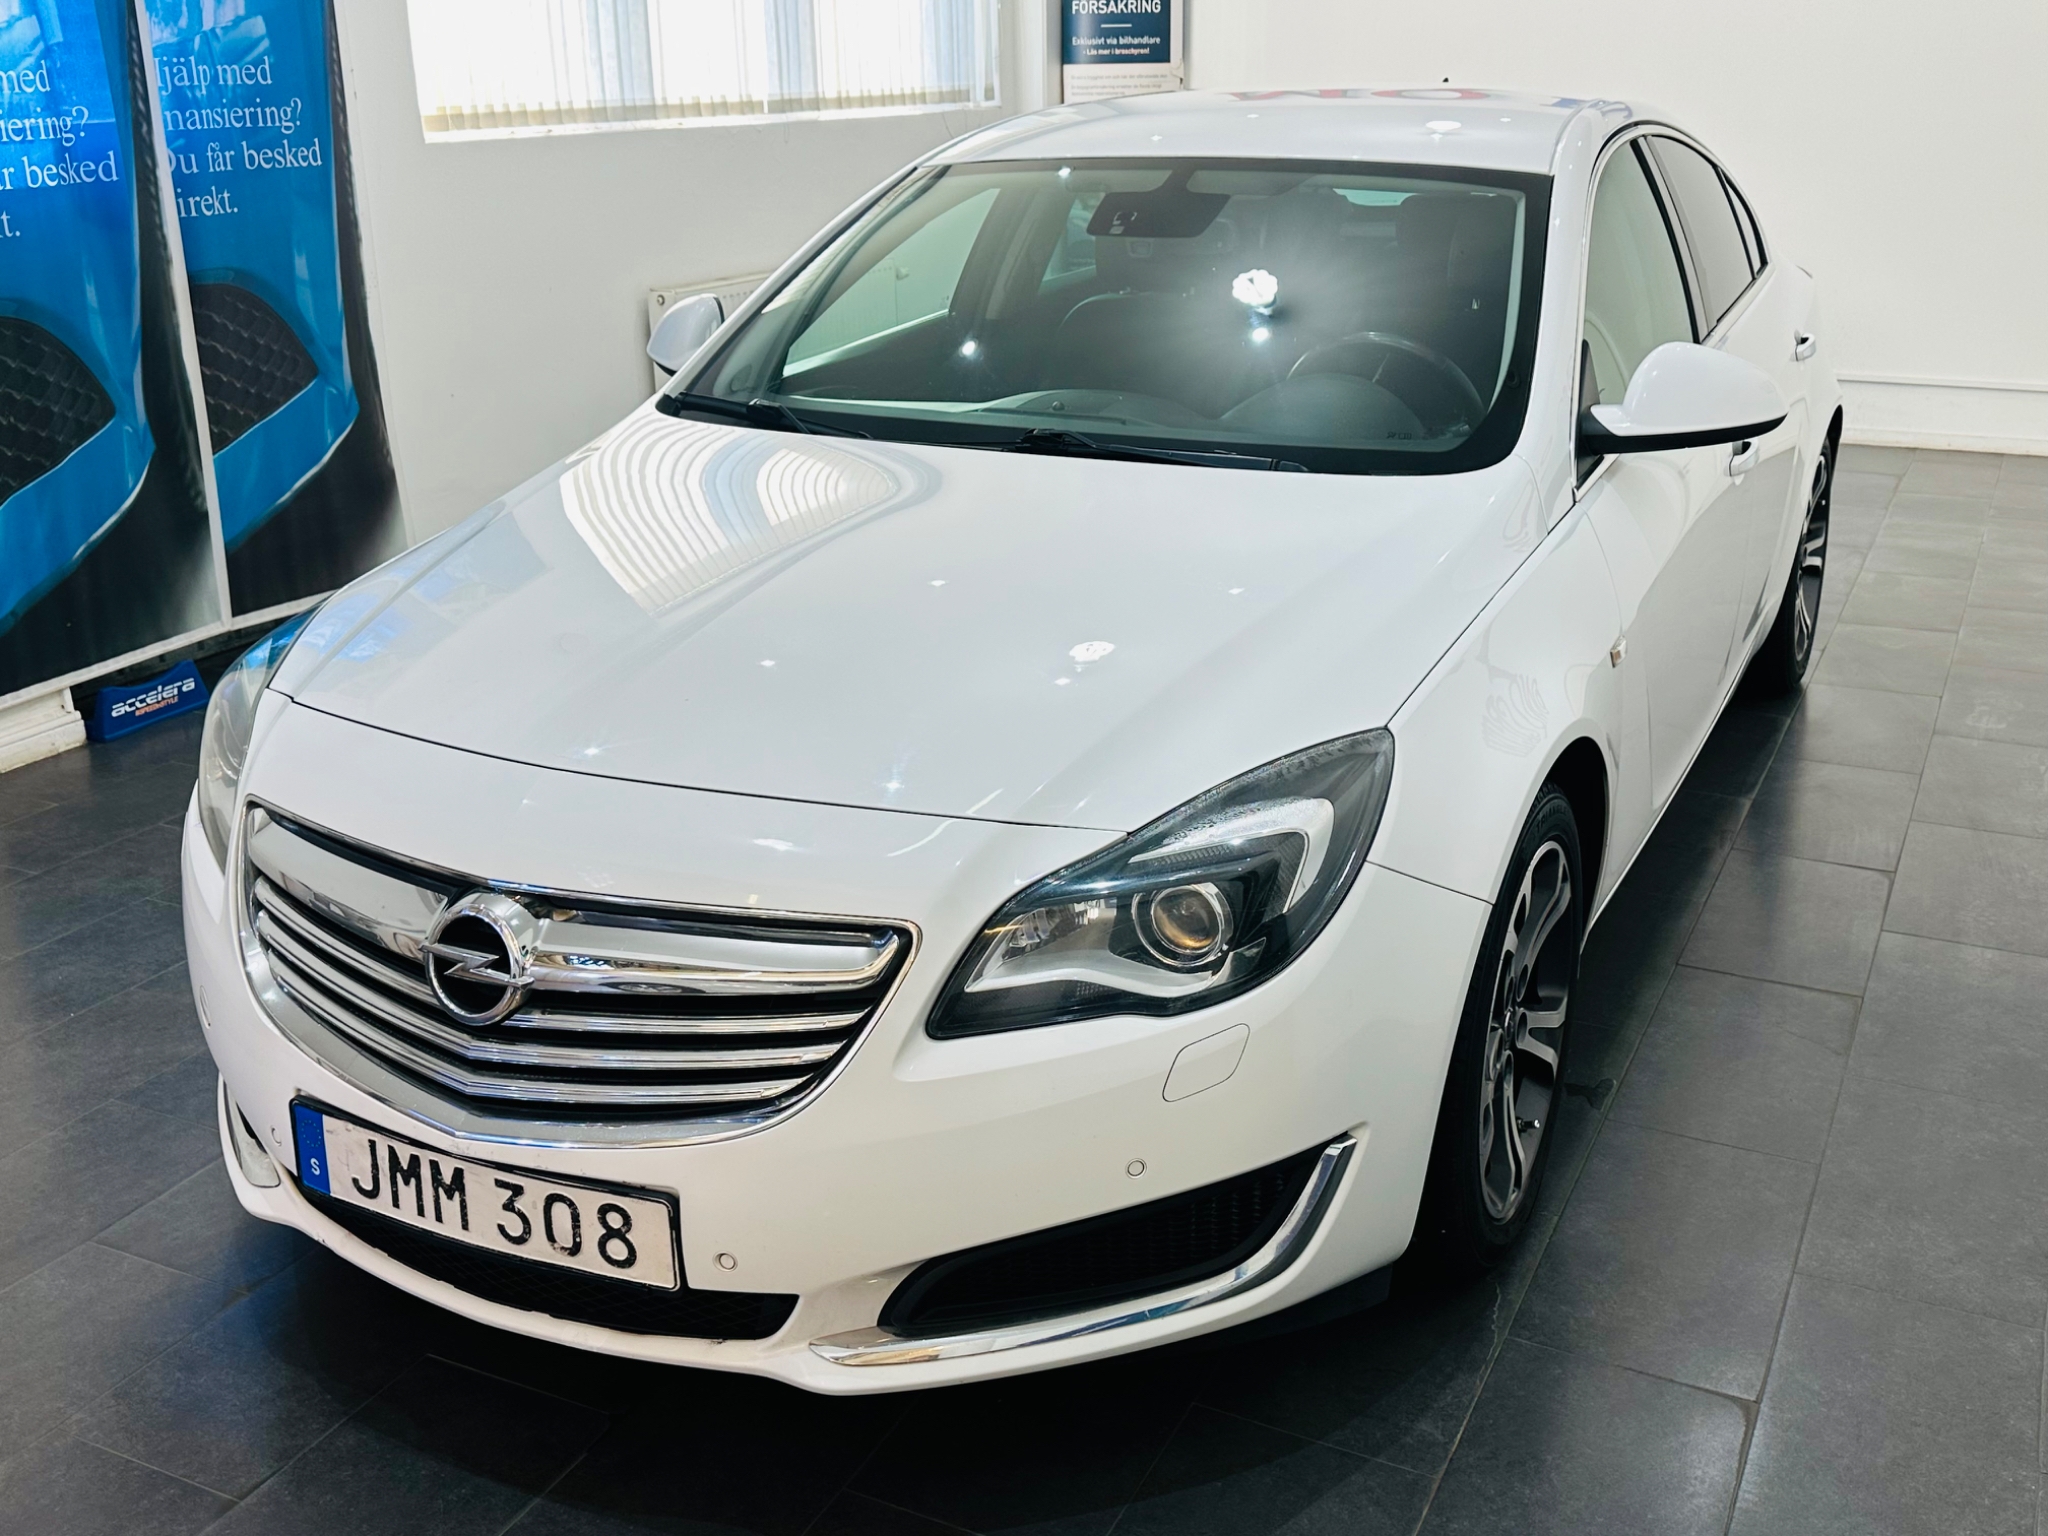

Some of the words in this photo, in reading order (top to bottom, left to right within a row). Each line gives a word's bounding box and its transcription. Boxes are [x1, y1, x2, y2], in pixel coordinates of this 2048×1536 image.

[1072, 36, 1105, 46] Exklusivt
[1106, 35, 1118, 45] via
[1118, 35, 1161, 45] bilhandlare
[216, 55, 272, 85] med
[164, 97, 302, 134] nansiering?
[21, 150, 119, 189] besked
[206, 141, 235, 173] får
[241, 138, 323, 170] besked
[176, 185, 239, 218] irekt.
[111, 677, 195, 717] accelera
[309, 1156, 321, 1176] S
[351, 1138, 470, 1232] JMM
[494, 1177, 638, 1270] 308
